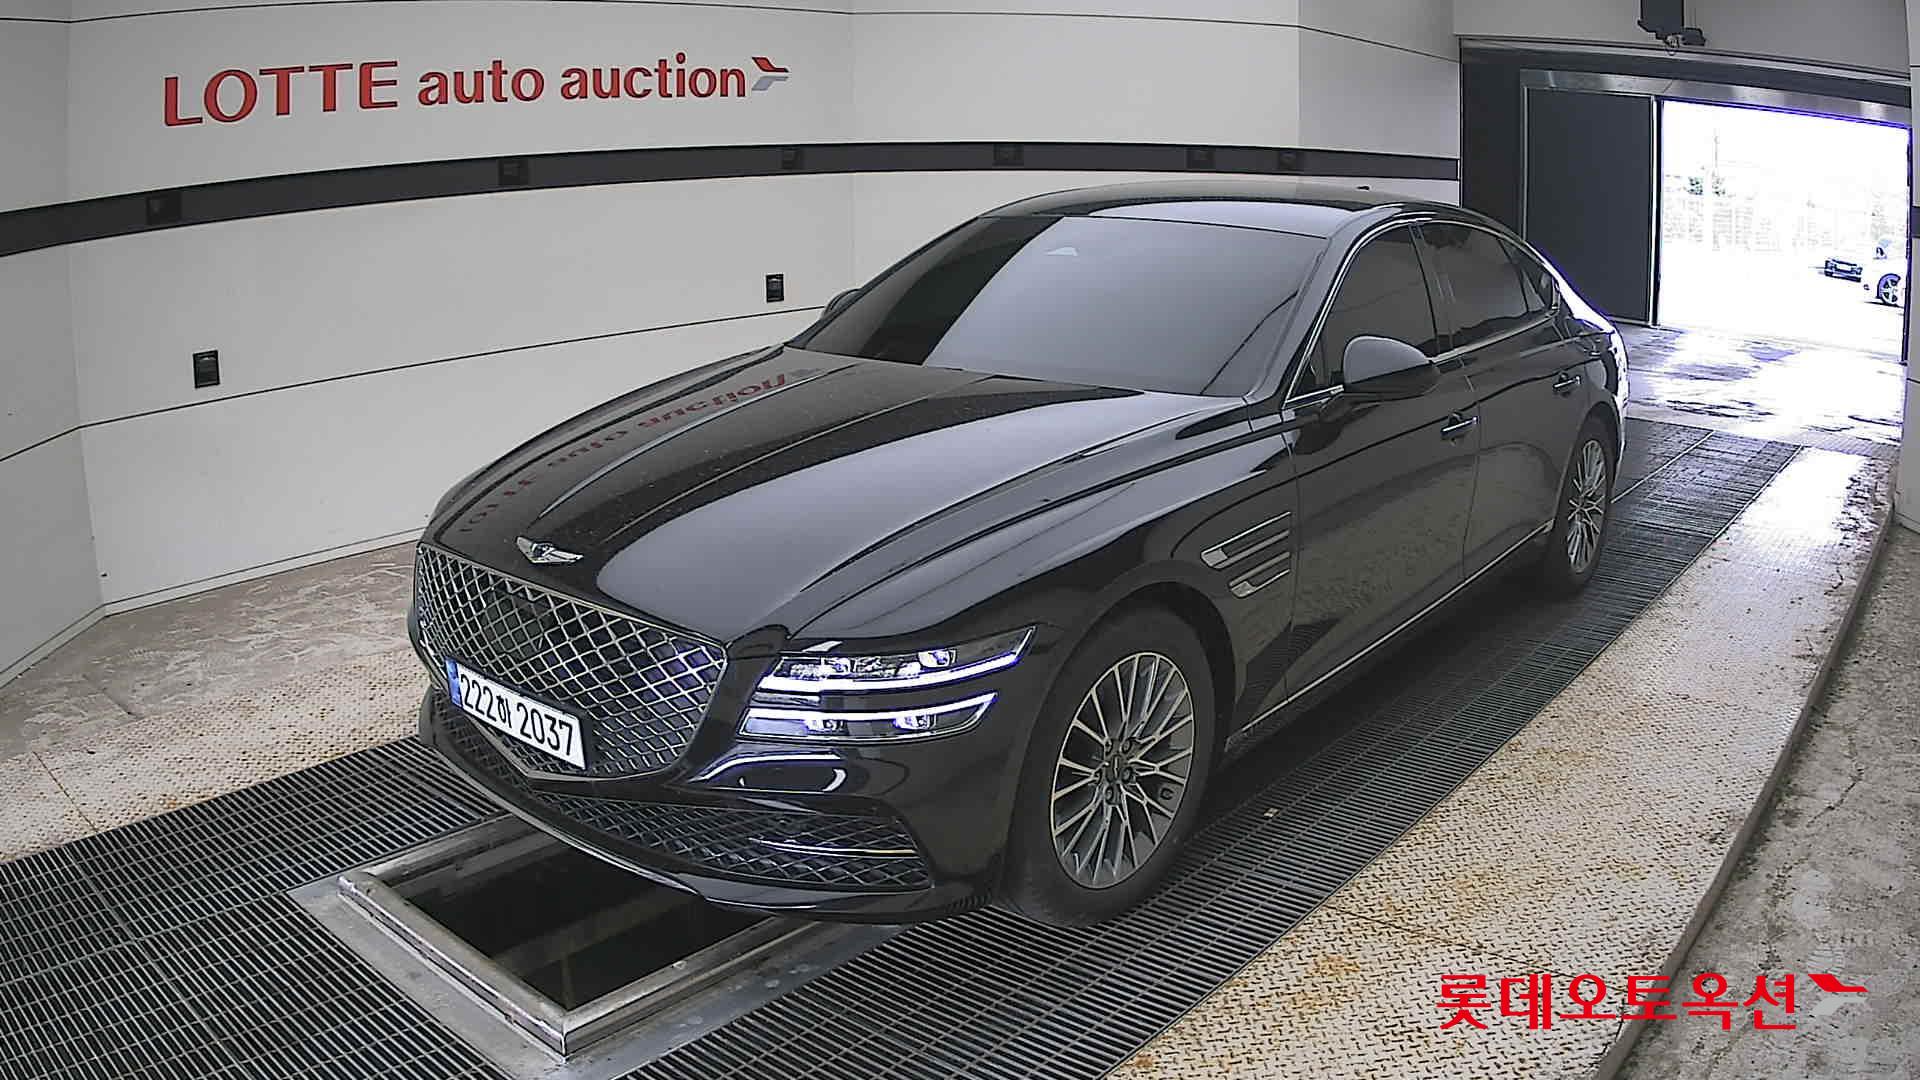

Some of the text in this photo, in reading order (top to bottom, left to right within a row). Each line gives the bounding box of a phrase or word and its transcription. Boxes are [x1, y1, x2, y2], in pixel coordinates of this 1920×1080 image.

[164, 52, 747, 127] LOTTE auto auction
[516, 702, 573, 757] 2037
